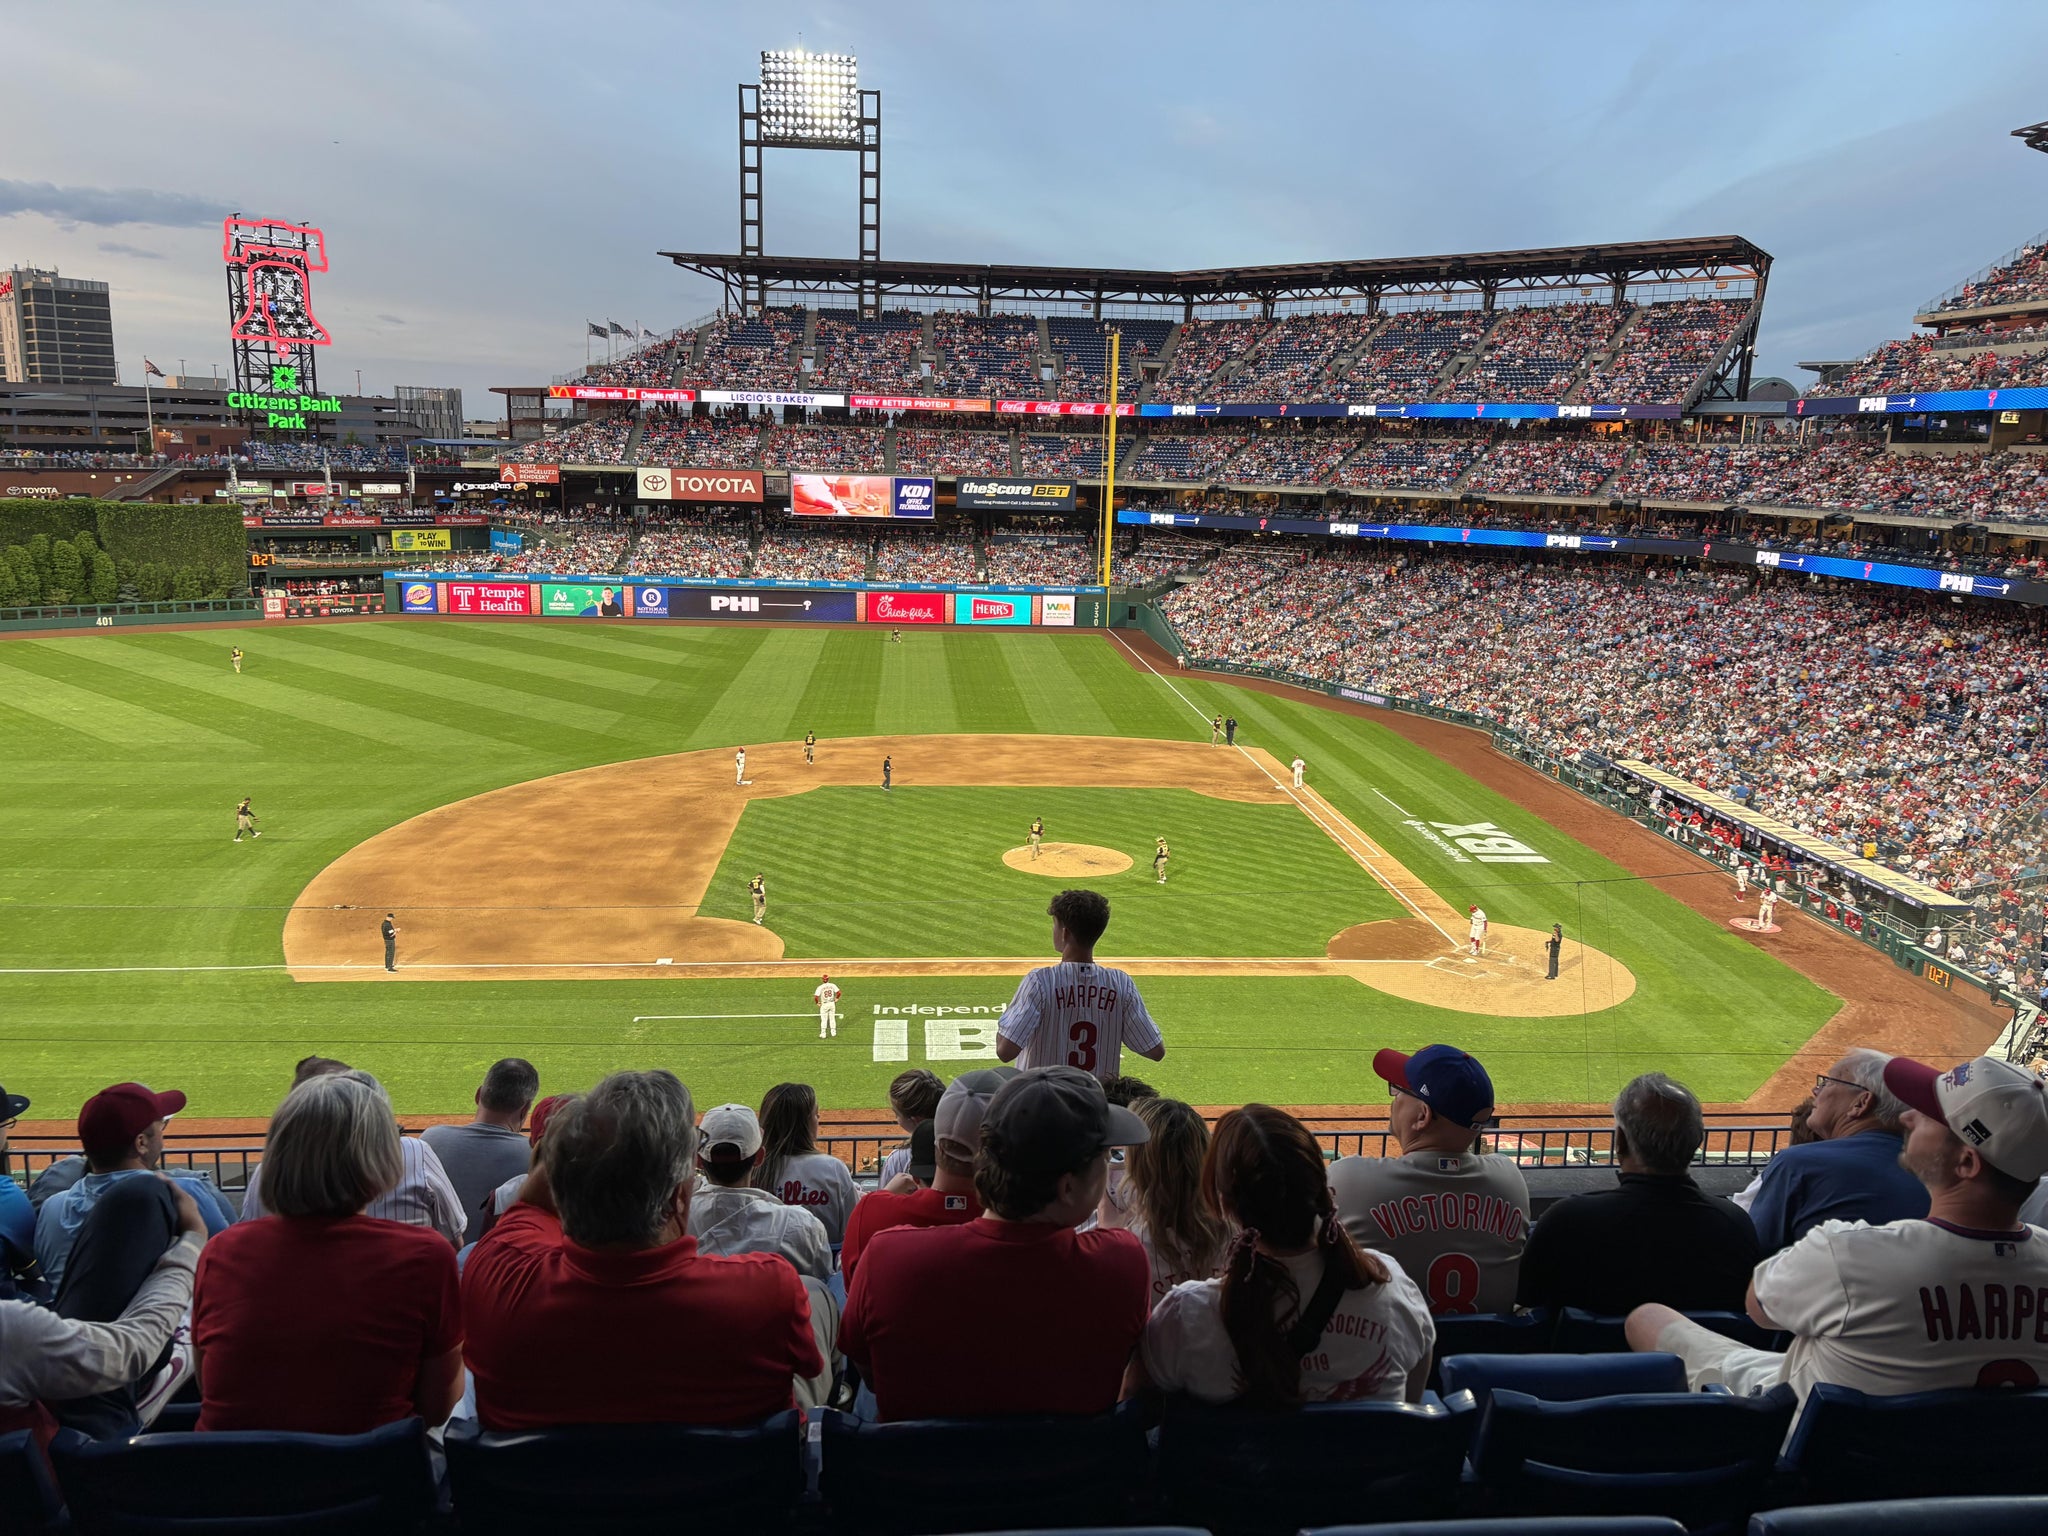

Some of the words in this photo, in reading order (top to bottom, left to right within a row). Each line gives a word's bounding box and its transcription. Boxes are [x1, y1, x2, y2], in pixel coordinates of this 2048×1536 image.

[576, 389, 606, 398] Phillies
[607, 390, 622, 398] win
[641, 392, 664, 400] Deals
[731, 394, 772, 402] LISCIO'S
[776, 396, 815, 404] BAKERY
[228, 392, 296, 410] Citizens
[300, 396, 342, 412] Bank
[1558, 406, 1592, 417] PHI
[268, 412, 306, 429] Park
[676, 477, 756, 494] TOYOTA
[900, 485, 932, 498] KDI
[962, 482, 1032, 496] theScore
[1036, 486, 1068, 496] BET
[1546, 535, 1580, 548] PHI
[1756, 551, 1780, 566] PHI
[1940, 574, 1974, 592] PHI
[478, 586, 524, 600] Temple
[480, 600, 522, 612] Health
[710, 596, 760, 612] PHI
[976, 603, 1008, 615] HERR'S
[1047, 603, 1071, 611] WM
[96, 617, 113, 626] 401
[1428, 821, 1552, 863] IBX
[1055, 984, 1117, 1012] HARPER
[872, 1003, 1008, 1016] Independ
[873, 1019, 1000, 1062] IB
[1068, 1020, 1097, 1072] 3
[1370, 1192, 1523, 1242] VICTORINO
[1427, 1252, 1480, 1314] 8
[1919, 1282, 2048, 1343] HARPE
[1326, 1313, 1388, 1344] SOCIETY
